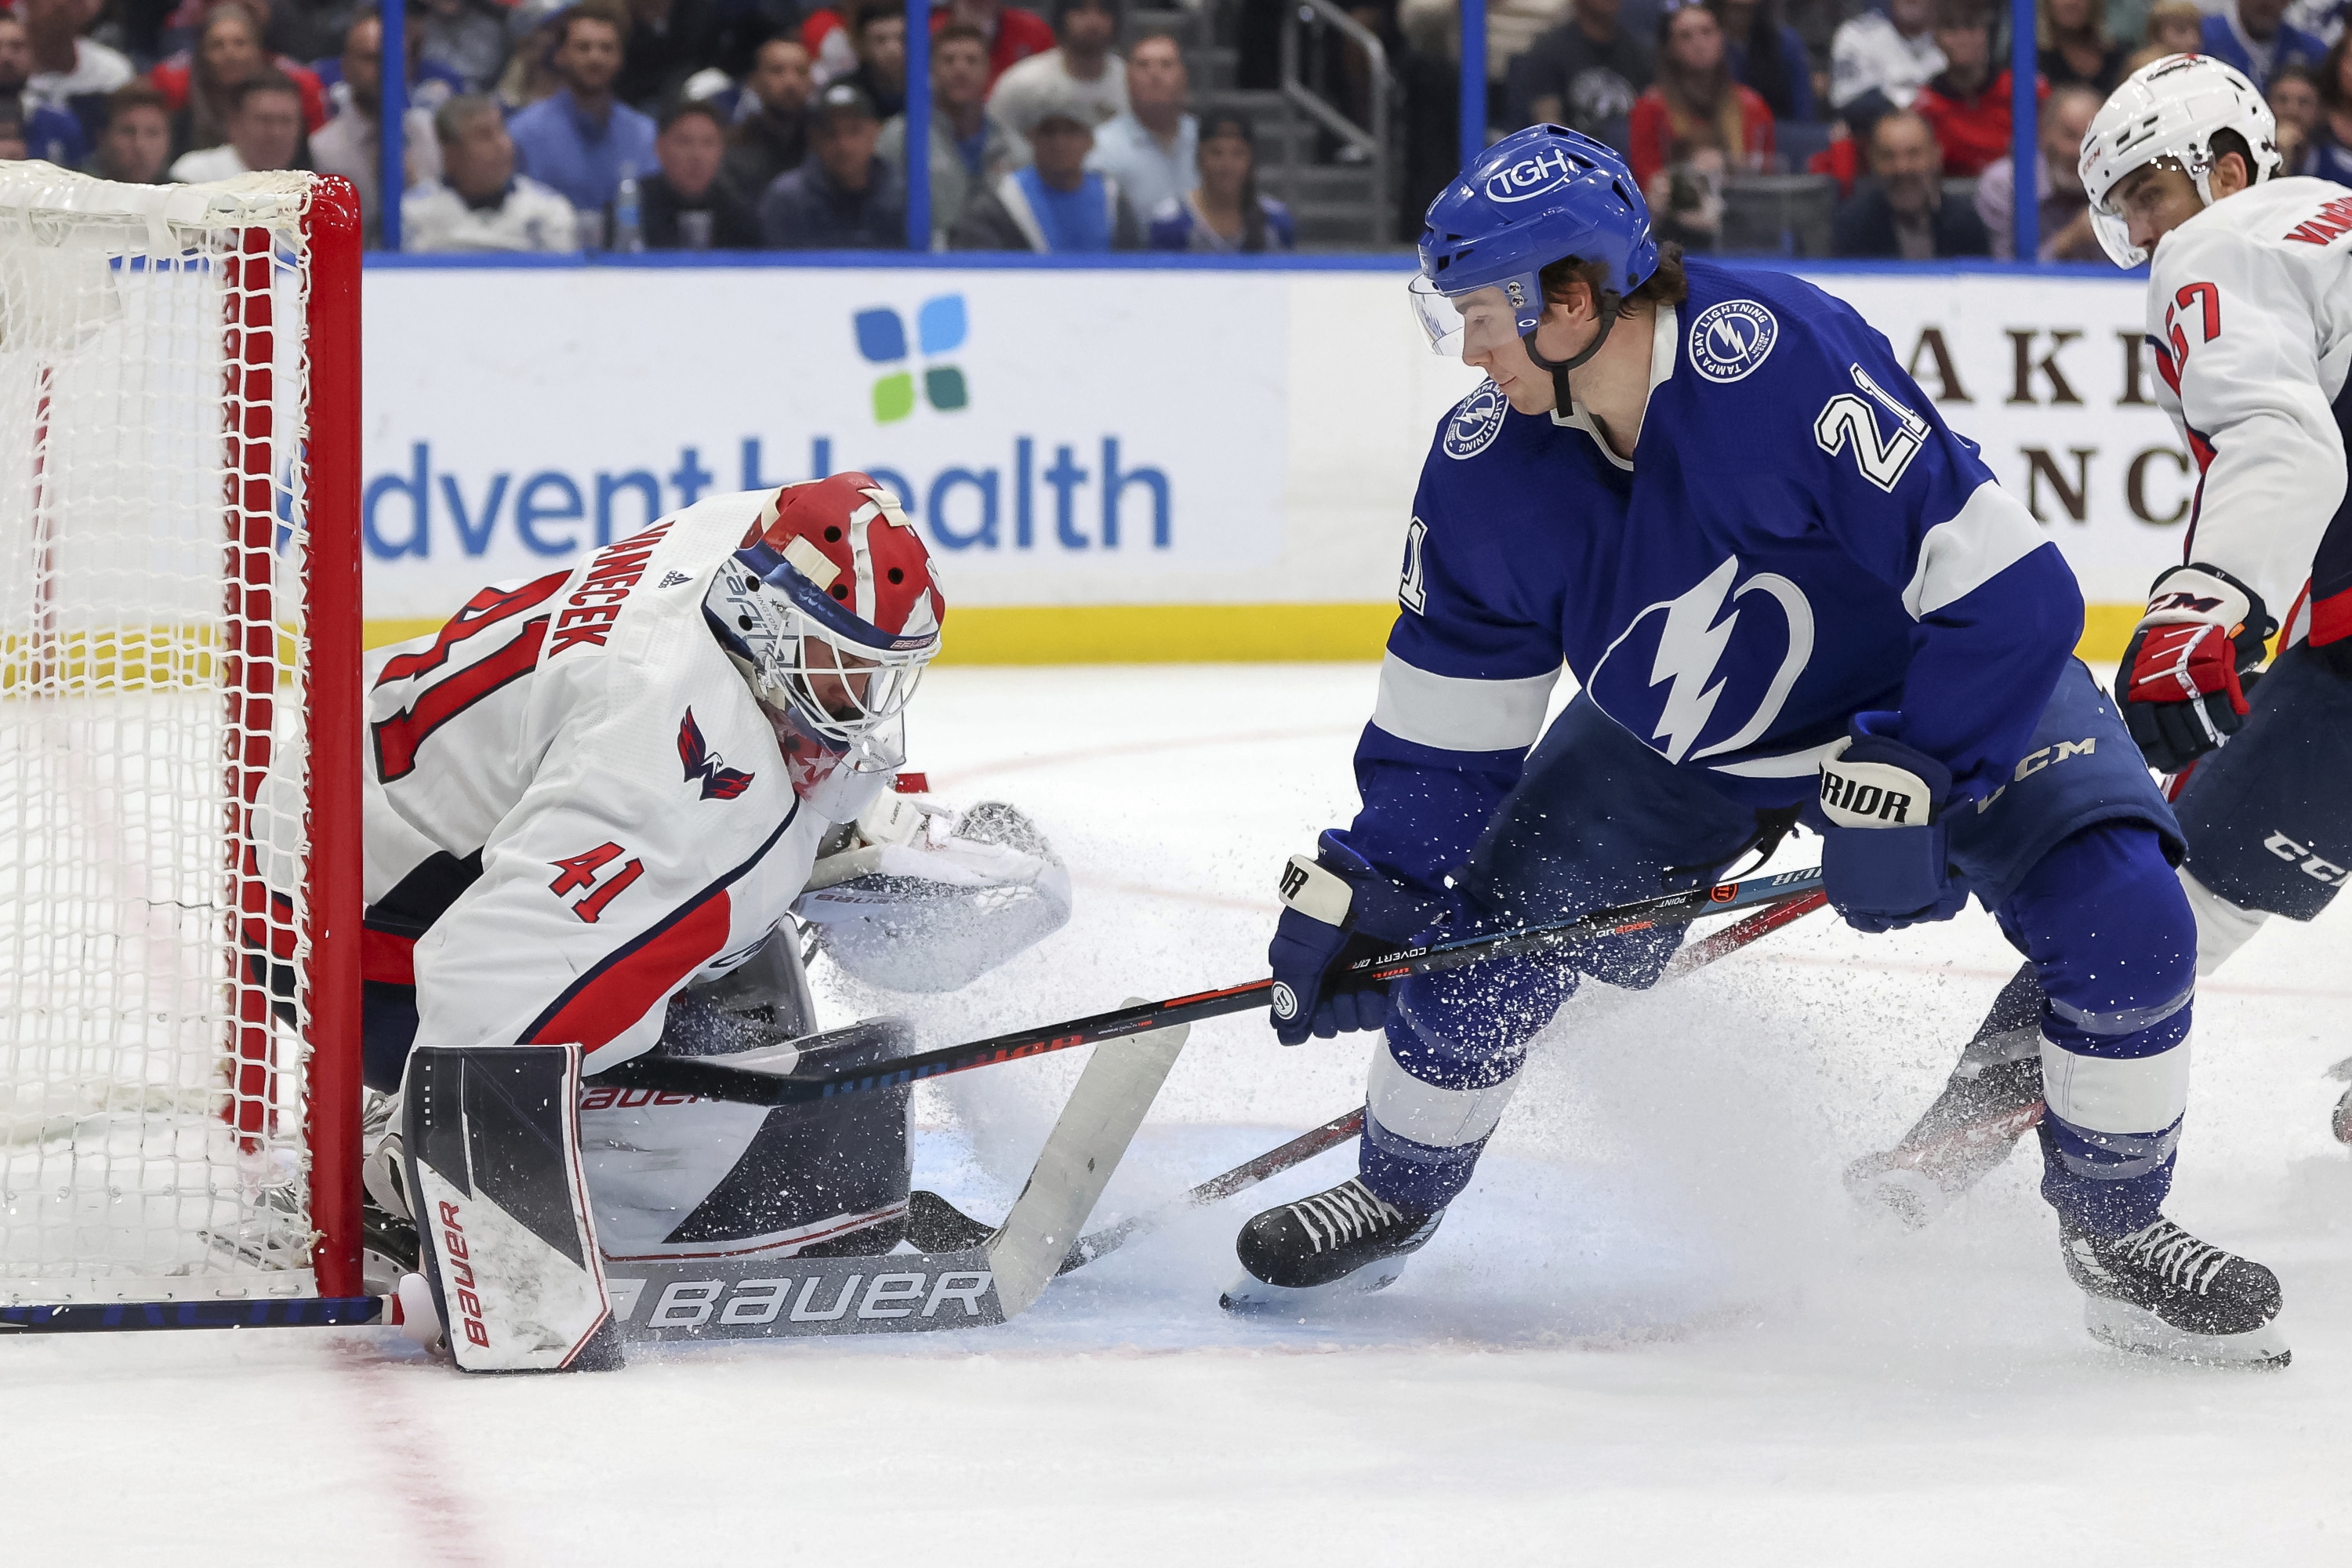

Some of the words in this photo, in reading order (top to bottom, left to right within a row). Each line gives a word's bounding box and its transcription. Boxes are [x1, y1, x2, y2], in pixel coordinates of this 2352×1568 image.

[1493, 149, 1567, 194] TGH
[1700, 303, 1769, 328] LIGHTNING
[1694, 332, 1706, 358] BAY
[1702, 356, 1742, 376] TAMPA
[1458, 400, 1504, 453] LIGHTNING
[1813, 362, 1932, 494] 21
[547, 520, 676, 660] VANECEK
[368, 568, 575, 786] 41
[546, 840, 645, 924] 41
[1660, 896, 1686, 908] POINT
[1376, 946, 1427, 965] COVERT
[439, 1200, 490, 1348] BAUER
[648, 1270, 993, 1330] BAUER
